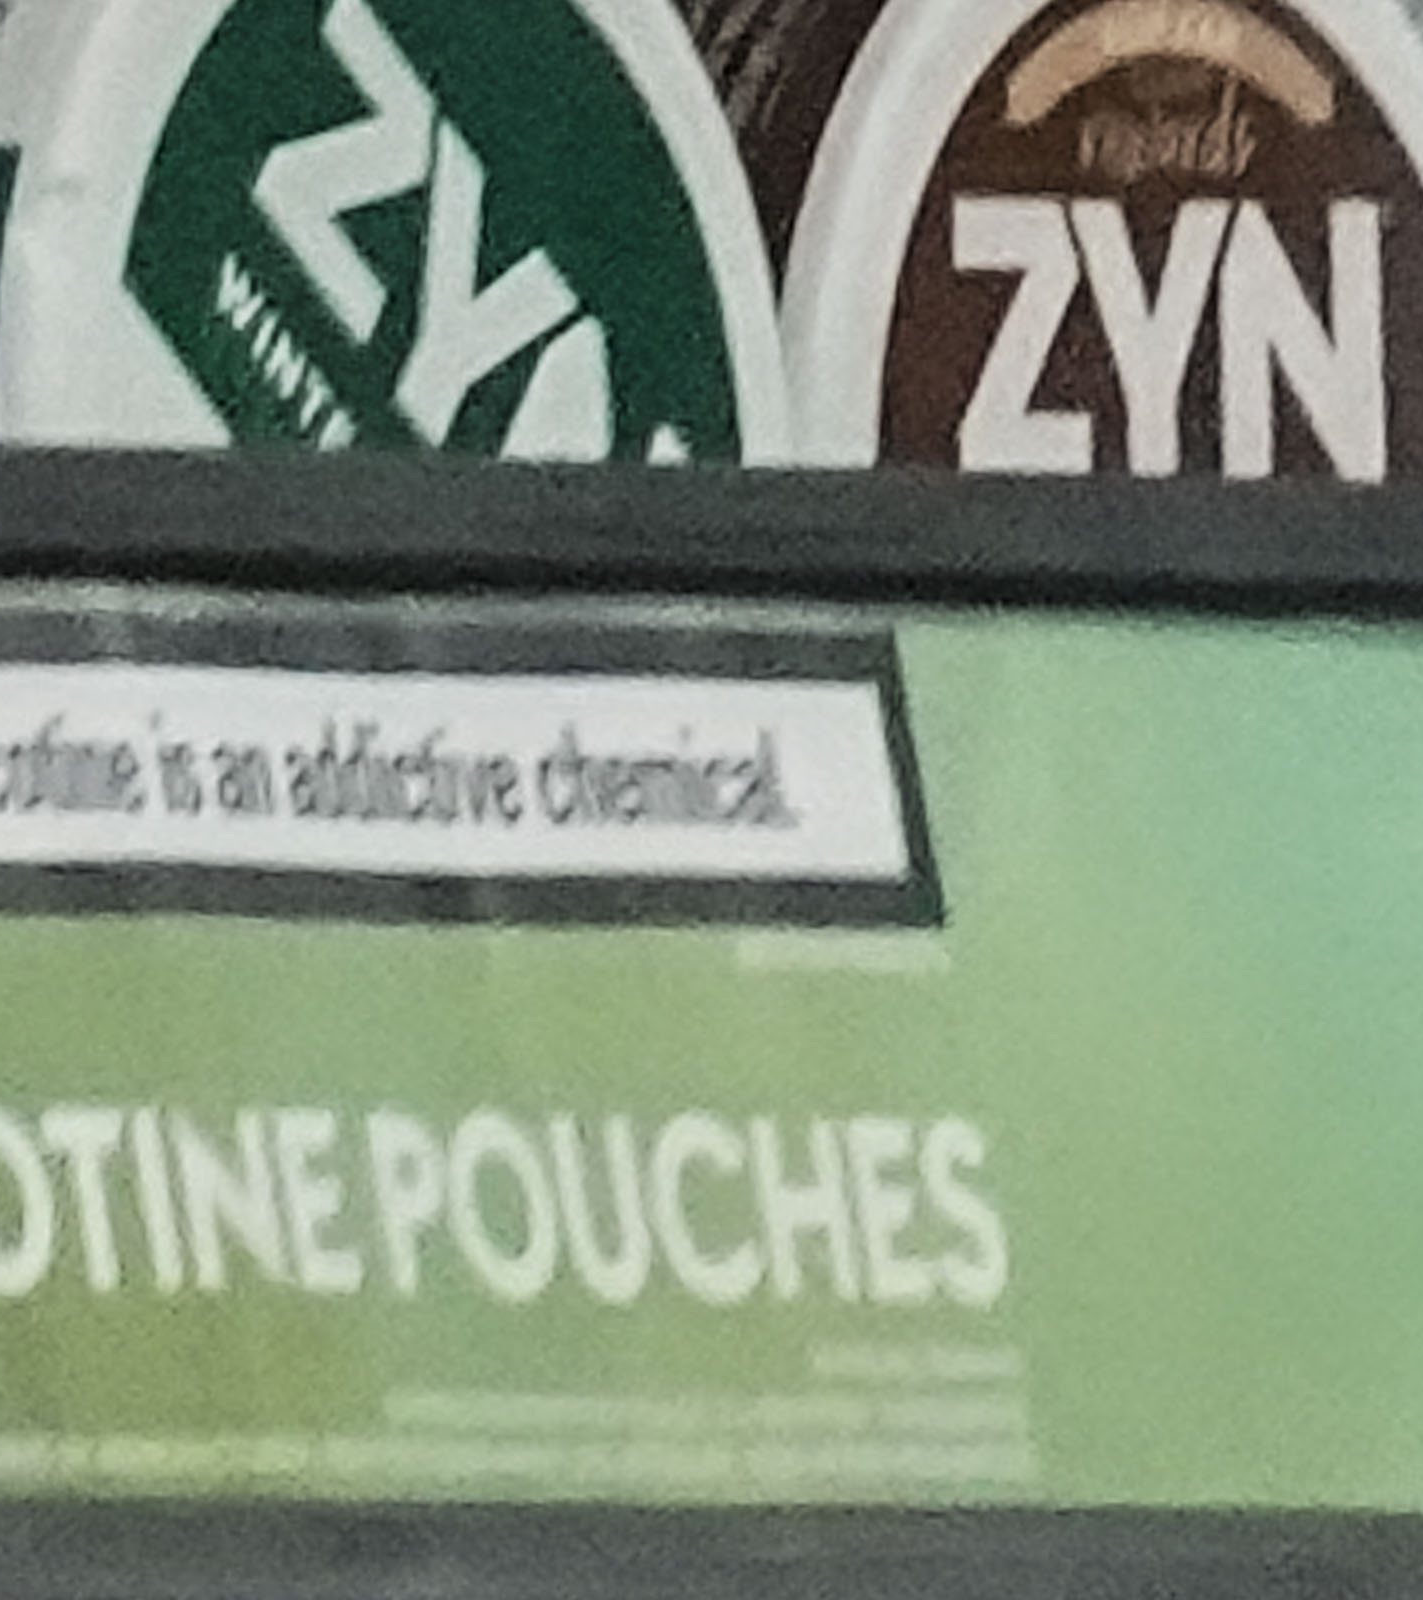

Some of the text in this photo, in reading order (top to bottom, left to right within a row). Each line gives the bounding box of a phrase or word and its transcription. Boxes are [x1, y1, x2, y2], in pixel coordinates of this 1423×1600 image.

[952, 196, 1390, 484] ZYN
[148, 710, 202, 814] is
[213, 740, 273, 816] an
[366, 1102, 1010, 1308] POUCHES
